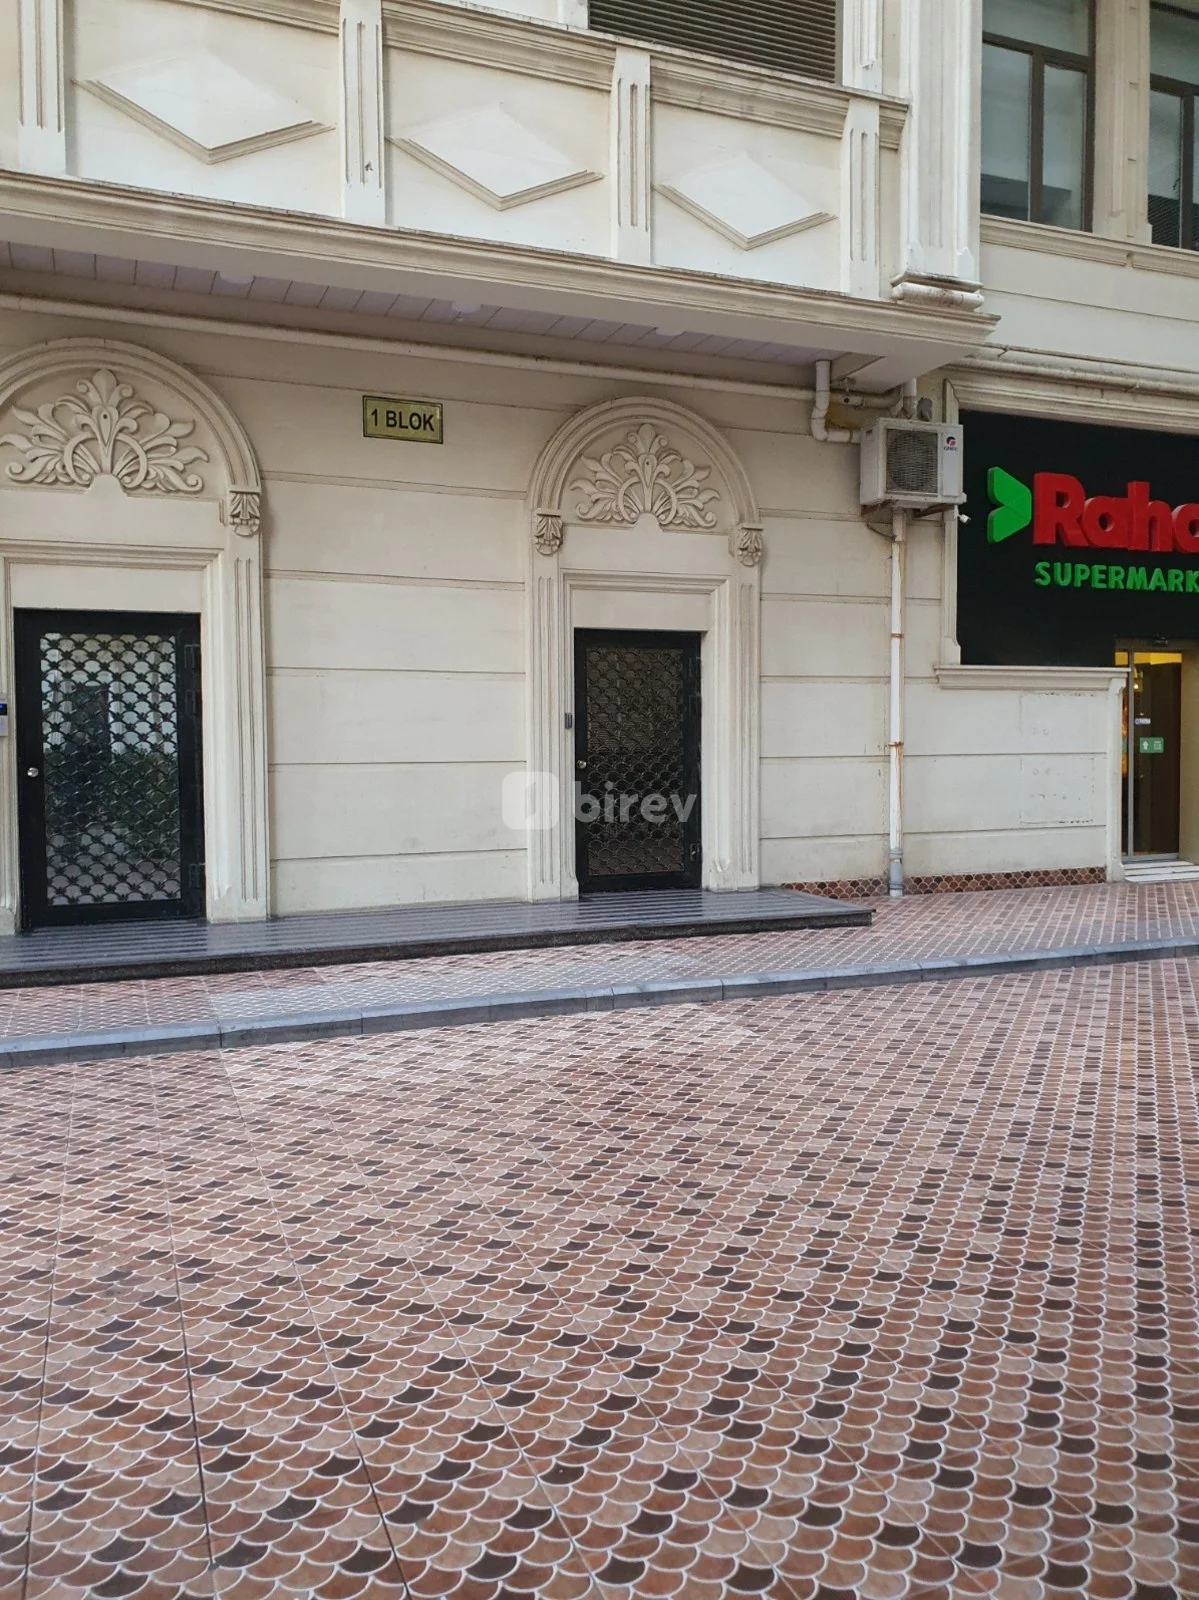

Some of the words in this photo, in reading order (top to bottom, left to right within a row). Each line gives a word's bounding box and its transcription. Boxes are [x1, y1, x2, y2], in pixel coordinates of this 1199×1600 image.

[371, 408, 378, 427] 1
[385, 410, 434, 432] BLOK
[1034, 561, 1199, 592] SUPERMARK
